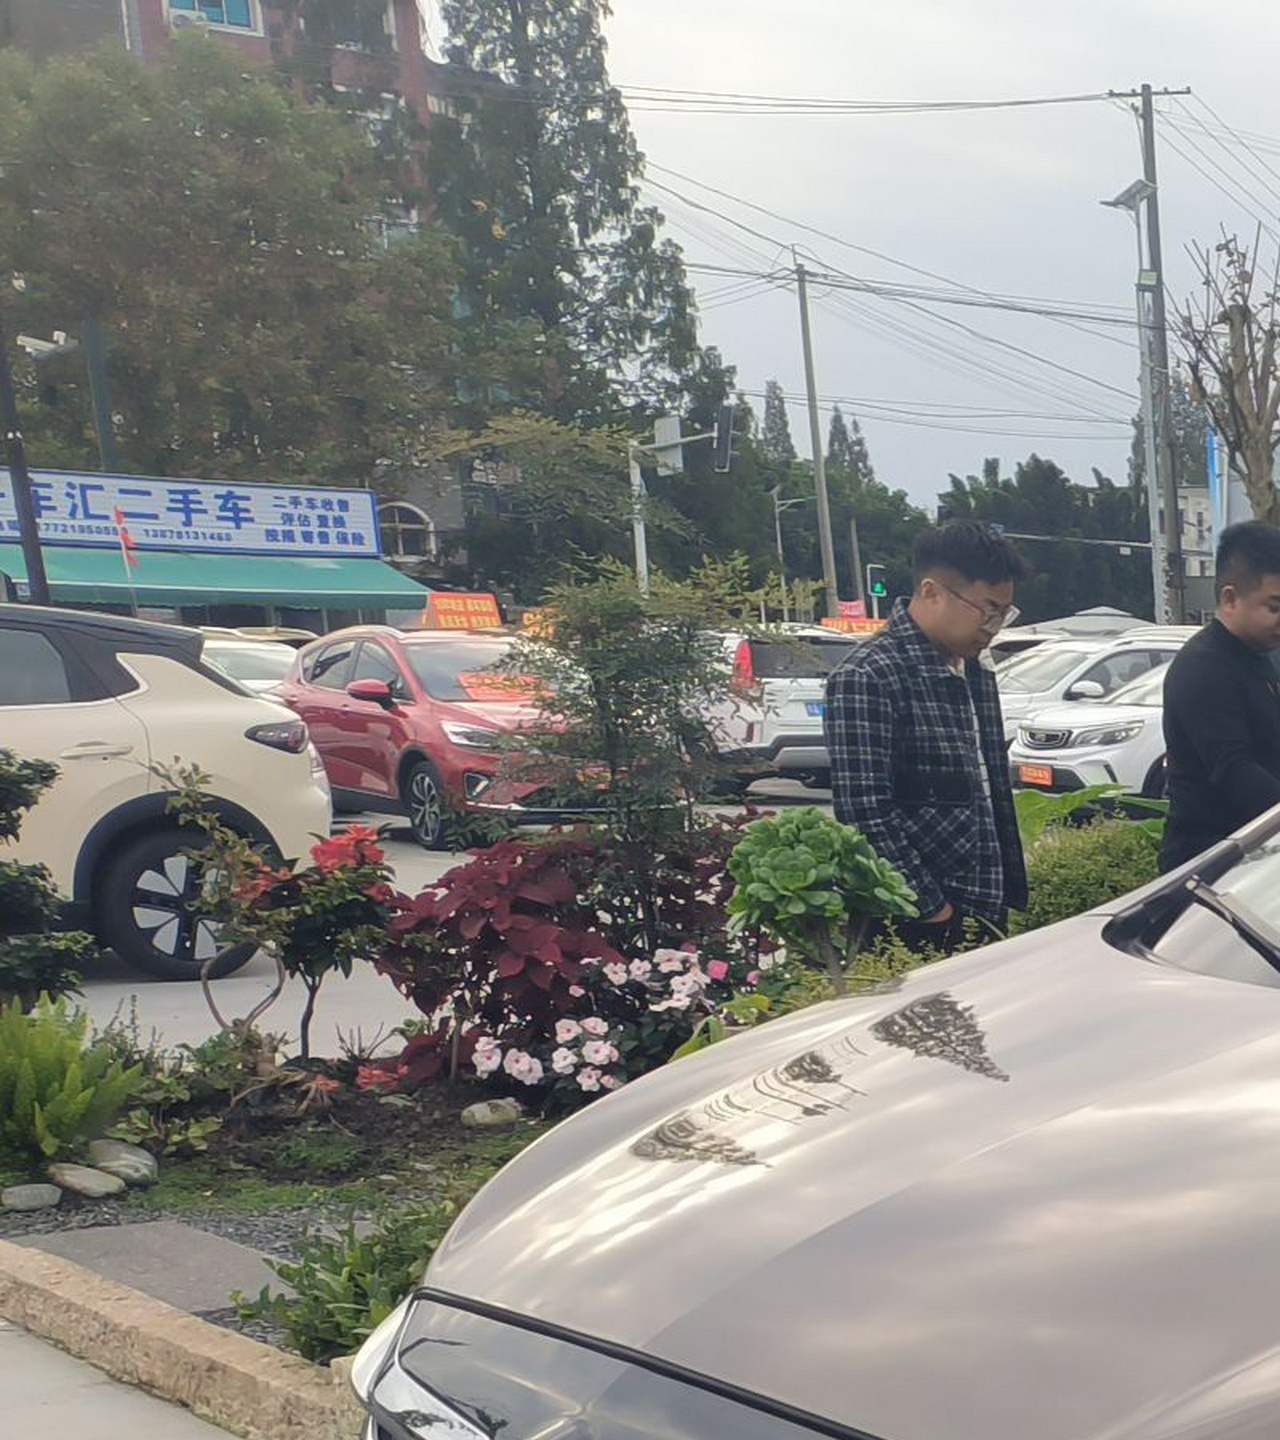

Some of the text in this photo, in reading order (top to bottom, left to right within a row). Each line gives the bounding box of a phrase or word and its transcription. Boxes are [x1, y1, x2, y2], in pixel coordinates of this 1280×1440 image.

[0, 481, 255, 530] 车汇二手车
